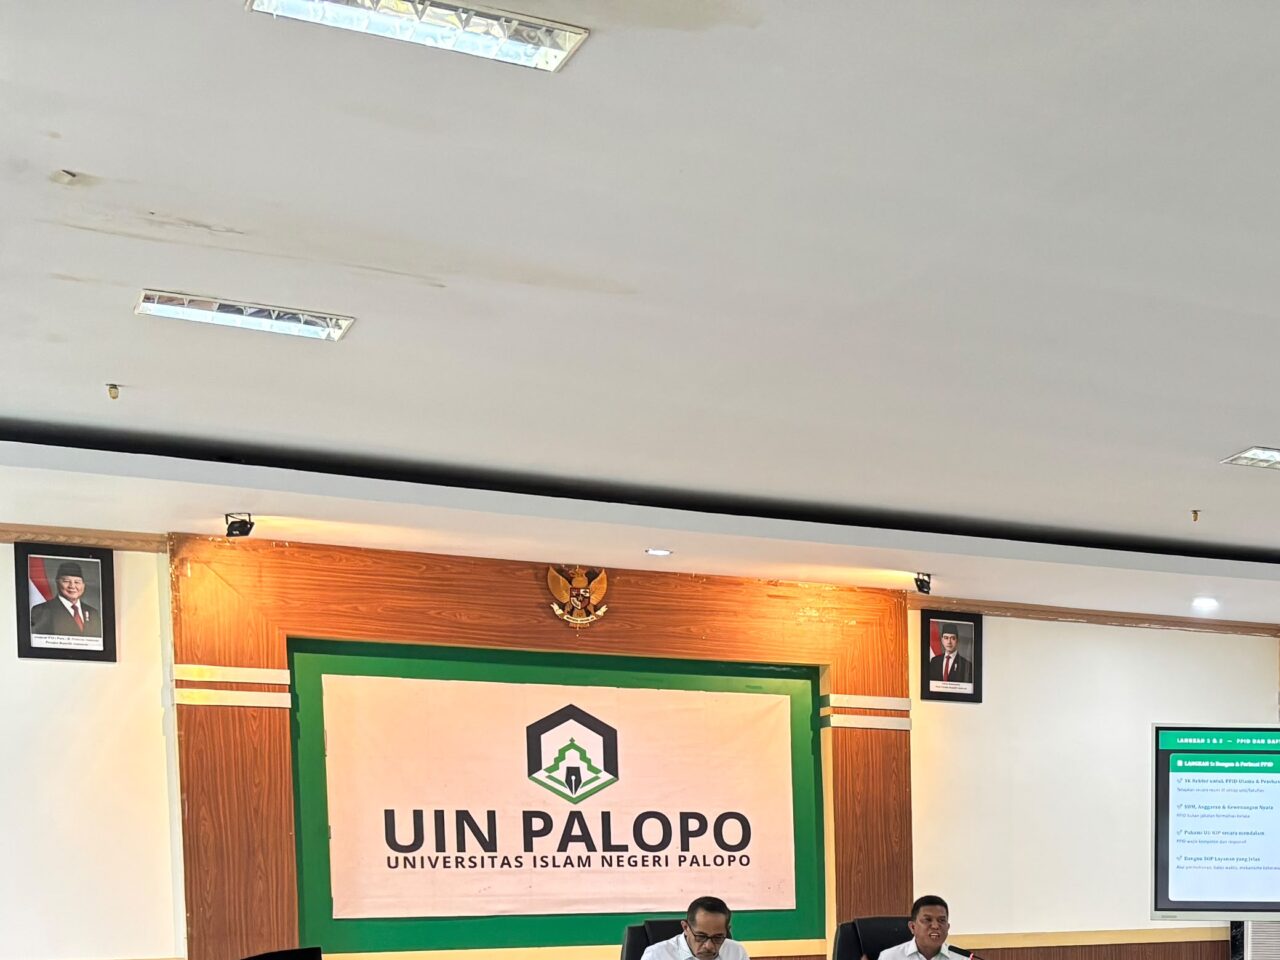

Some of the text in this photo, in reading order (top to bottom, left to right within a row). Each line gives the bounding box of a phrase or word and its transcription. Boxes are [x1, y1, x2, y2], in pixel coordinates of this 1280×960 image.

[384, 808, 752, 854] UIN PALOPO
[386, 853, 751, 869] UNIVERSITAS ISLAM NEGERI PALOPO
